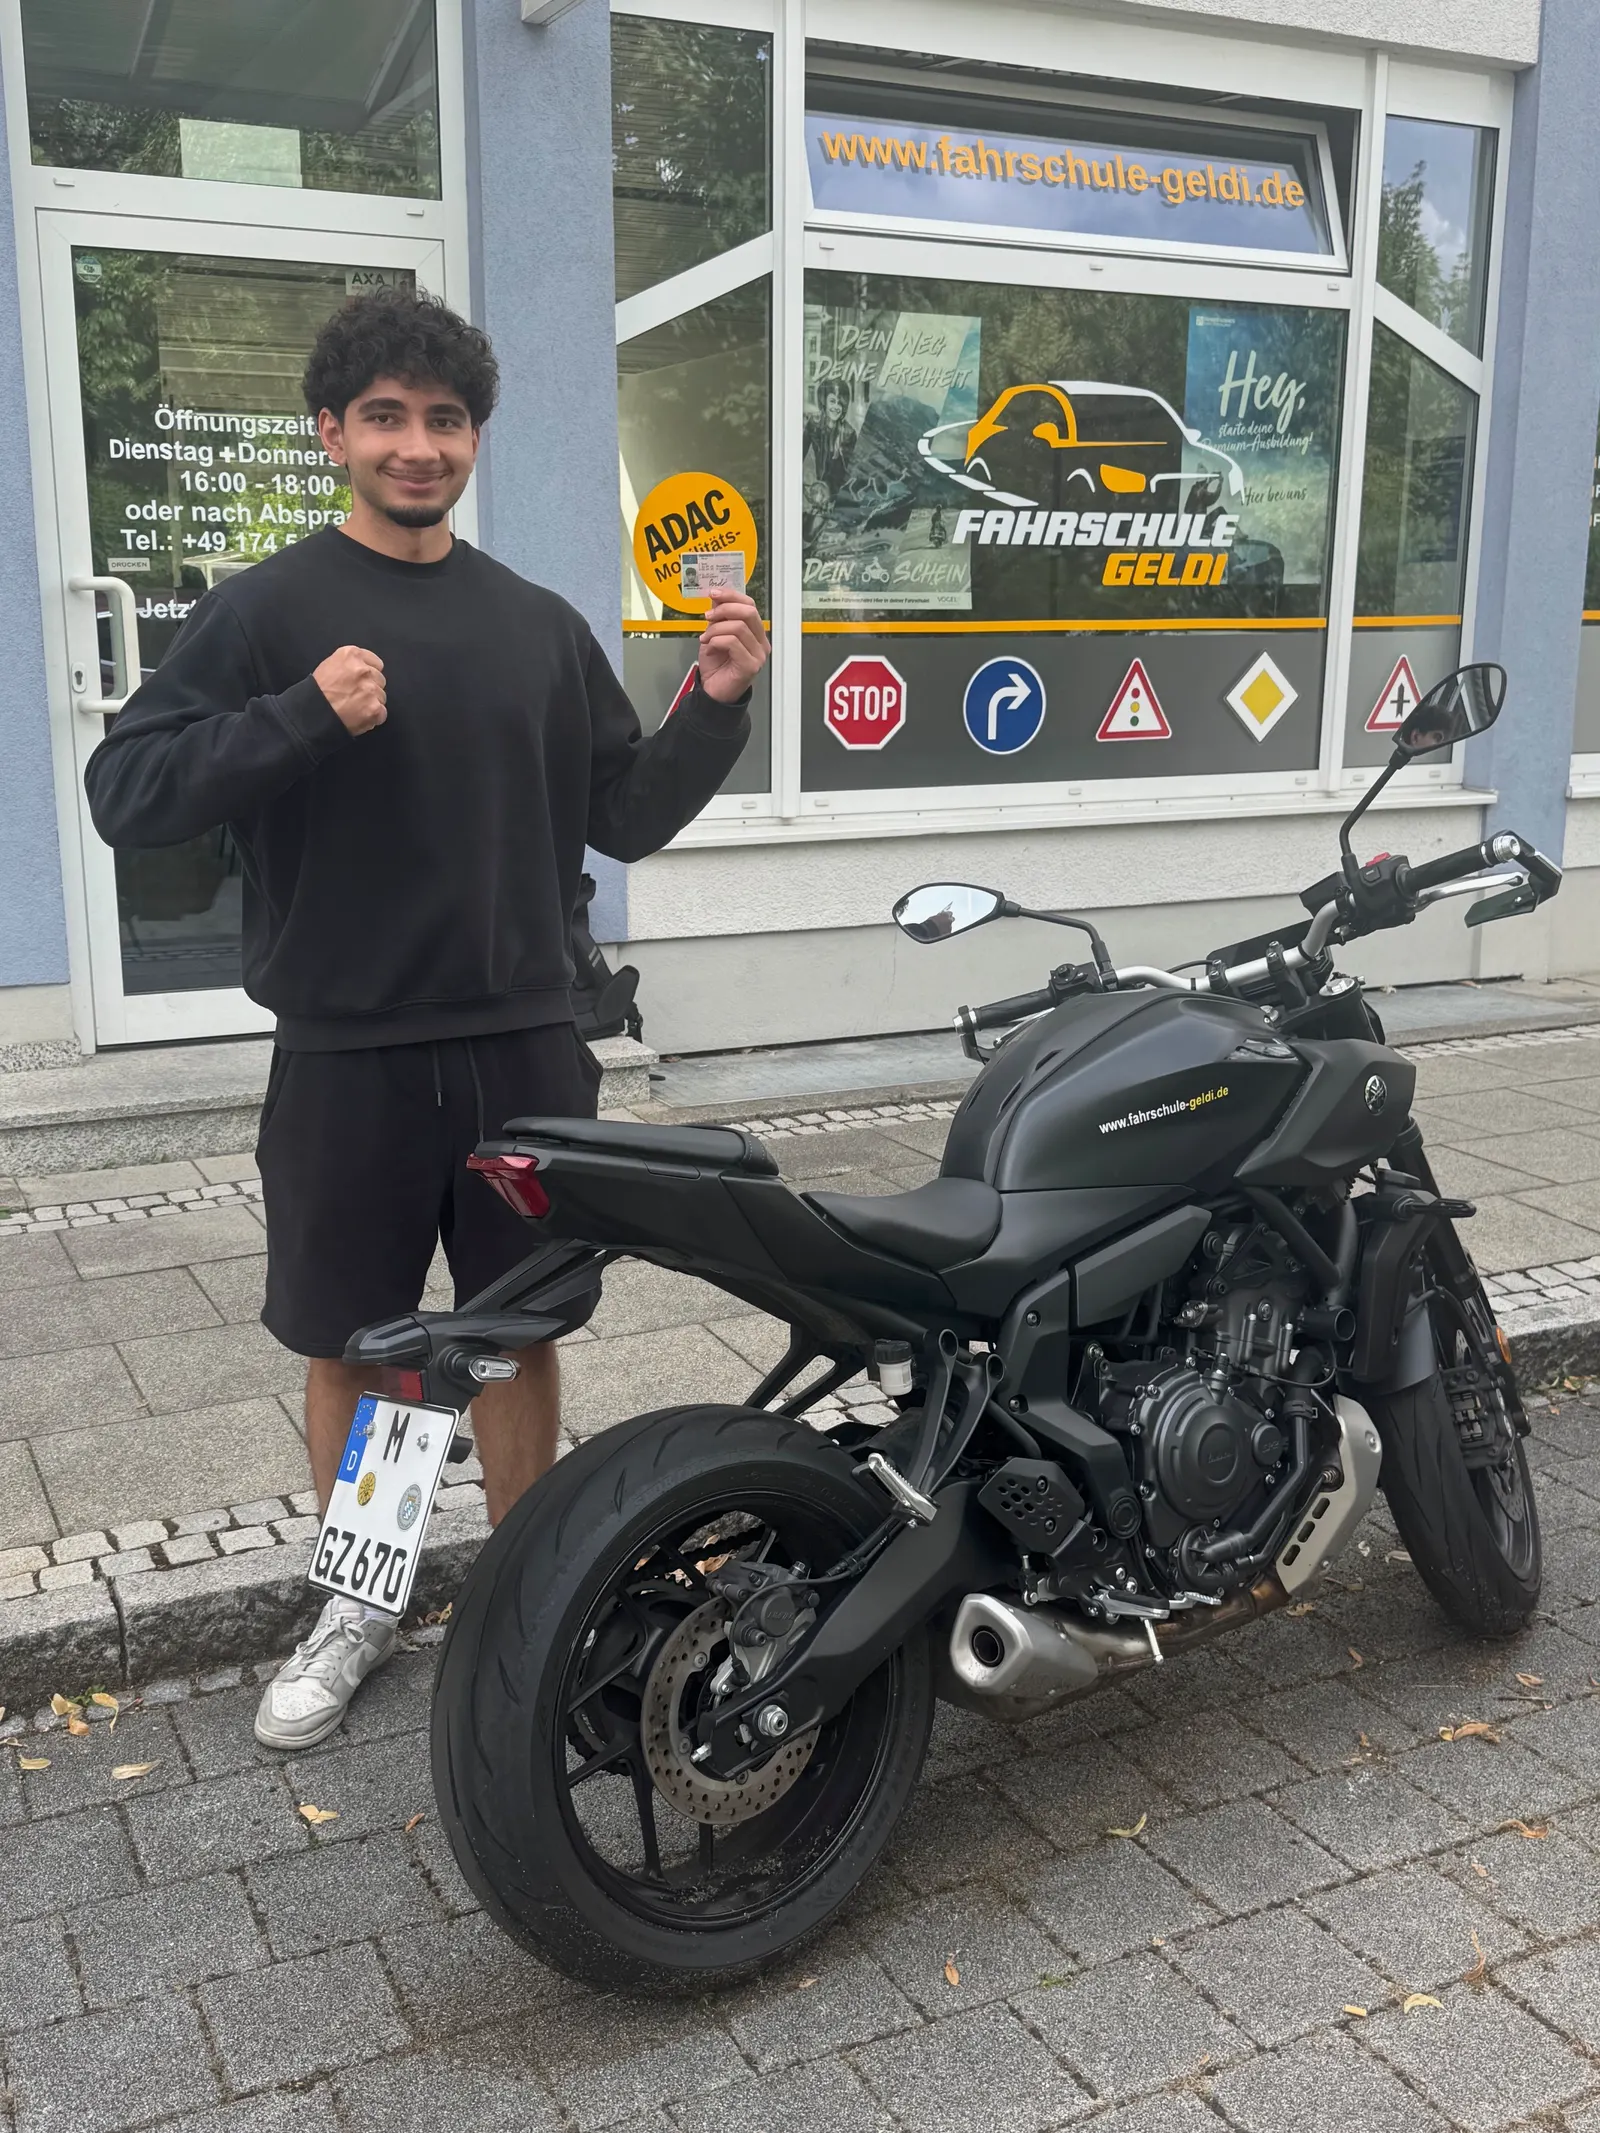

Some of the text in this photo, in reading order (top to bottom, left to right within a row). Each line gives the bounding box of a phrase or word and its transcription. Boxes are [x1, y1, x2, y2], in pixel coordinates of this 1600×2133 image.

[822, 130, 1305, 207] www.fahrschule-geldi.de
[351, 271, 386, 285] AXA
[838, 325, 946, 358] DEIN WEG
[812, 355, 878, 383] DEINE
[1218, 350, 1307, 434] Hey,
[1218, 420, 1274, 438] starte deine
[109, 438, 213, 467] Dienstag
[180, 470, 246, 493] 16:00
[271, 473, 336, 496] 18:00
[1287, 488, 1308, 501] uns
[125, 499, 352, 530] oder nach Abspra
[643, 489, 731, 562] ADAC
[952, 509, 1240, 547] FAHRSCHULE
[120, 528, 173, 551] Tel.:
[182, 530, 227, 552] +49
[236, 533, 277, 553] 174
[654, 530, 741, 583] Moitäts-
[803, 558, 856, 583] DEIN
[1102, 552, 1229, 586] GELDI
[833, 685, 897, 721] STOP
[1098, 1086, 1229, 1134] www.fahrschule-geldi.de
[383, 1410, 411, 1463] M
[346, 1450, 358, 1471] D
